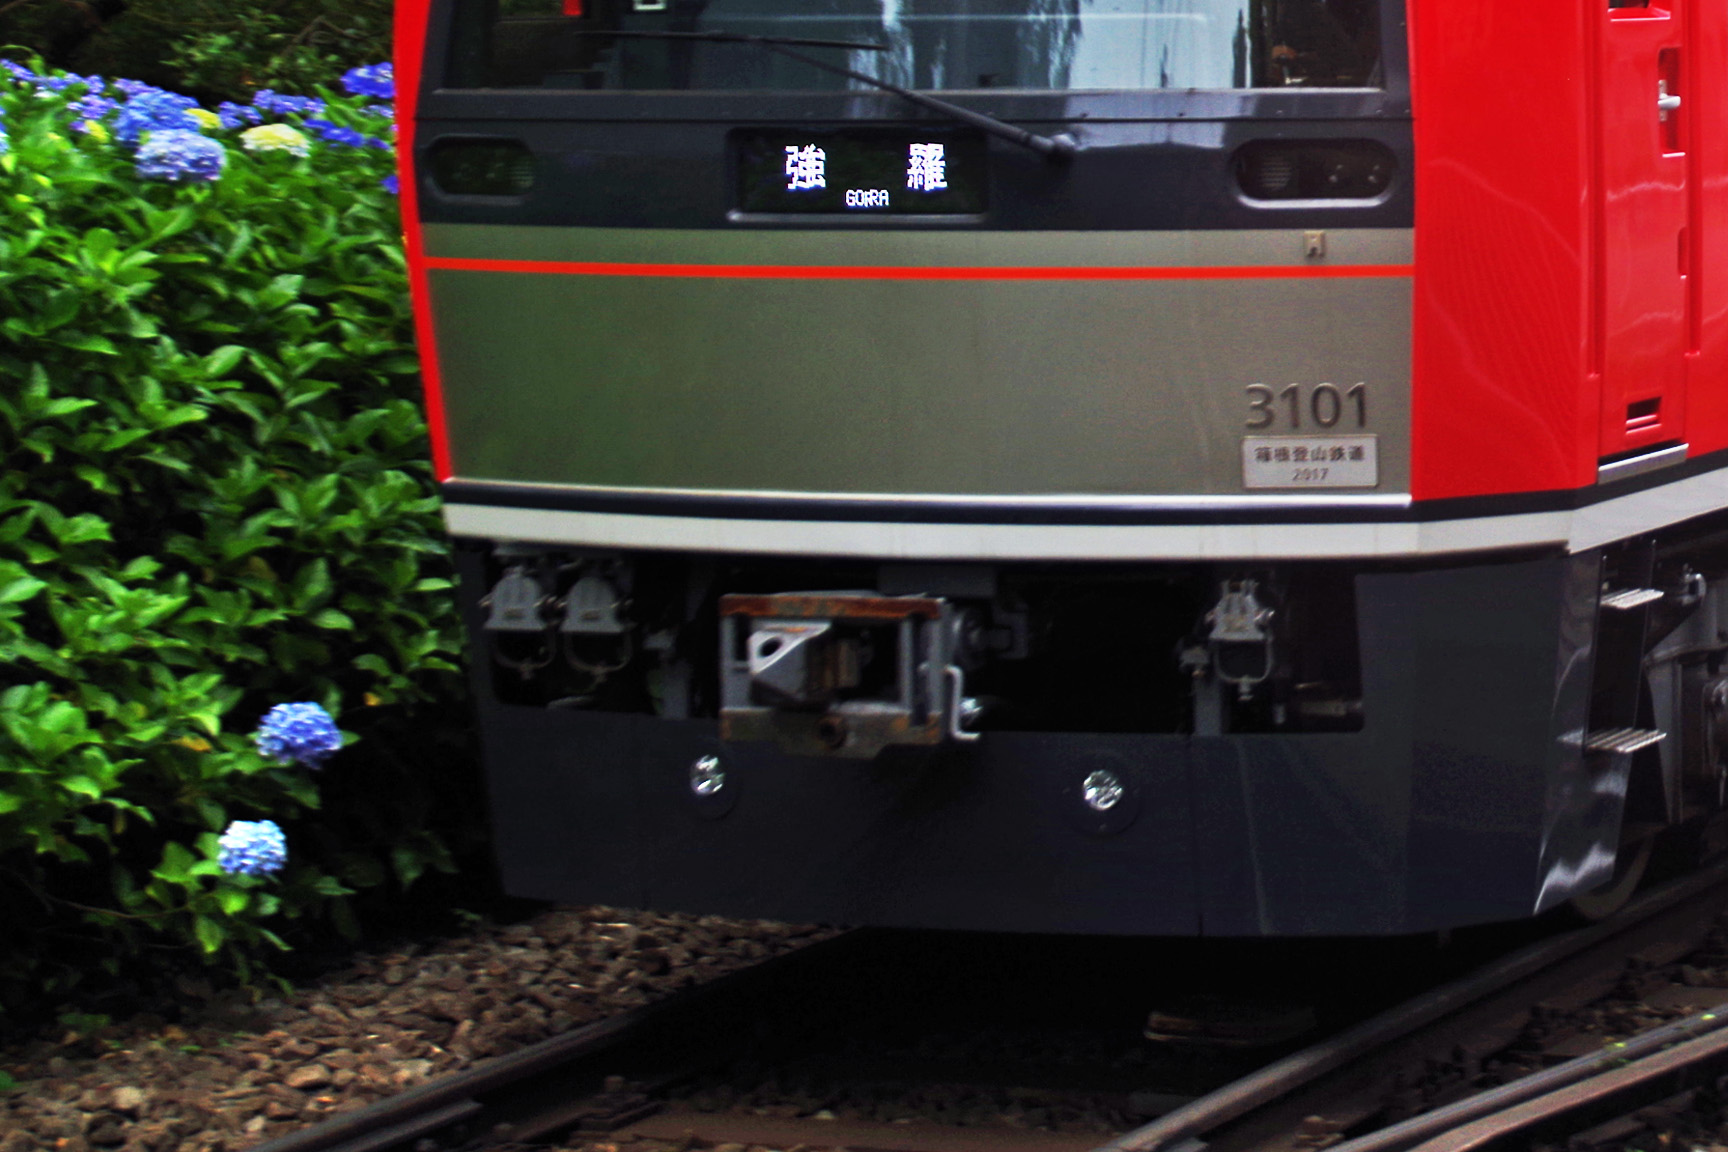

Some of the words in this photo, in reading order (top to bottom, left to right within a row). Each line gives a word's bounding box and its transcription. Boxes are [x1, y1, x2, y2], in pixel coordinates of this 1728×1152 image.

[785, 142, 948, 191] 強羅
[845, 188, 890, 207] GORA
[1245, 382, 1366, 429] 3101
